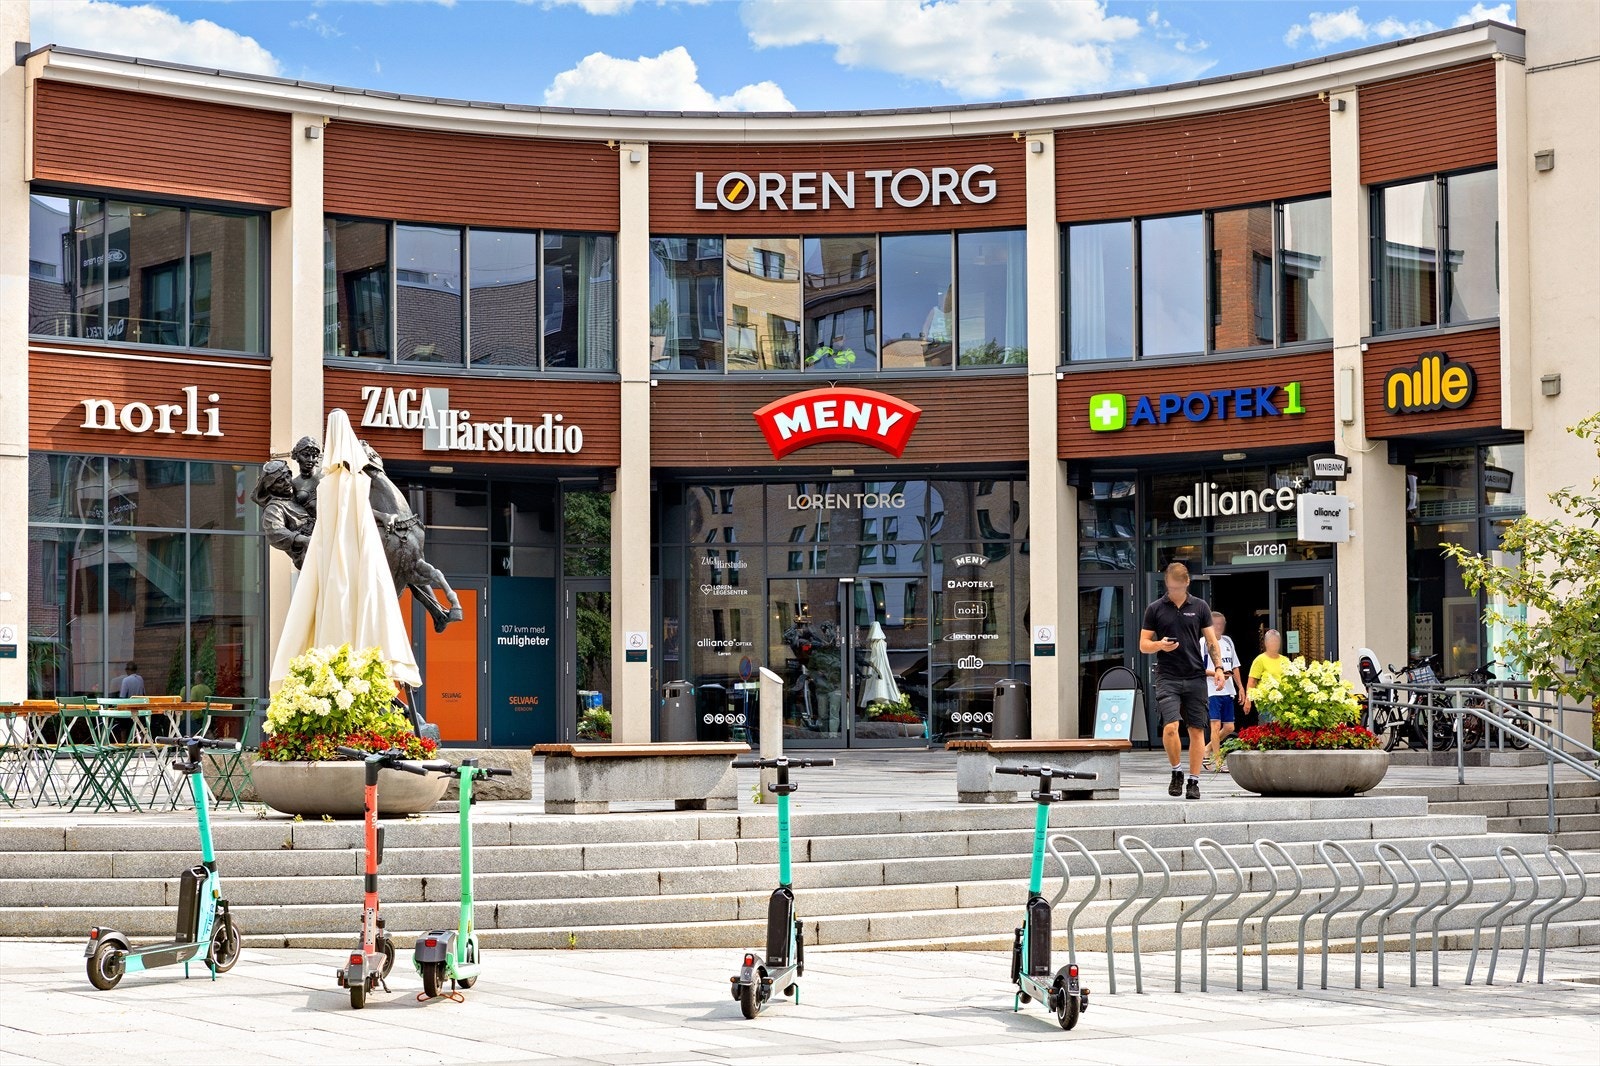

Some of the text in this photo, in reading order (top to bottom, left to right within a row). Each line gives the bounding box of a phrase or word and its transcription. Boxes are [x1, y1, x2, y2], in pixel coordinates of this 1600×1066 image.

[695, 164, 997, 211] LØREN TORG
[1387, 355, 1470, 410] nille
[80, 386, 224, 437] norli
[360, 386, 583, 454] ZAGA Hårstudio
[773, 400, 904, 440] MENY
[1315, 463, 1344, 472] MINIBANK
[787, 493, 906, 510] LØREN TORG
[1246, 541, 1287, 557] Løren
[955, 556, 987, 566] MENY
[958, 604, 984, 614] norli
[501, 625, 546, 634] 107 kvm med
[497, 634, 550, 648] muligheter
[958, 655, 984, 669] nille
[509, 696, 539, 705] SELVAAG
[205, 904, 215, 935] TIER
